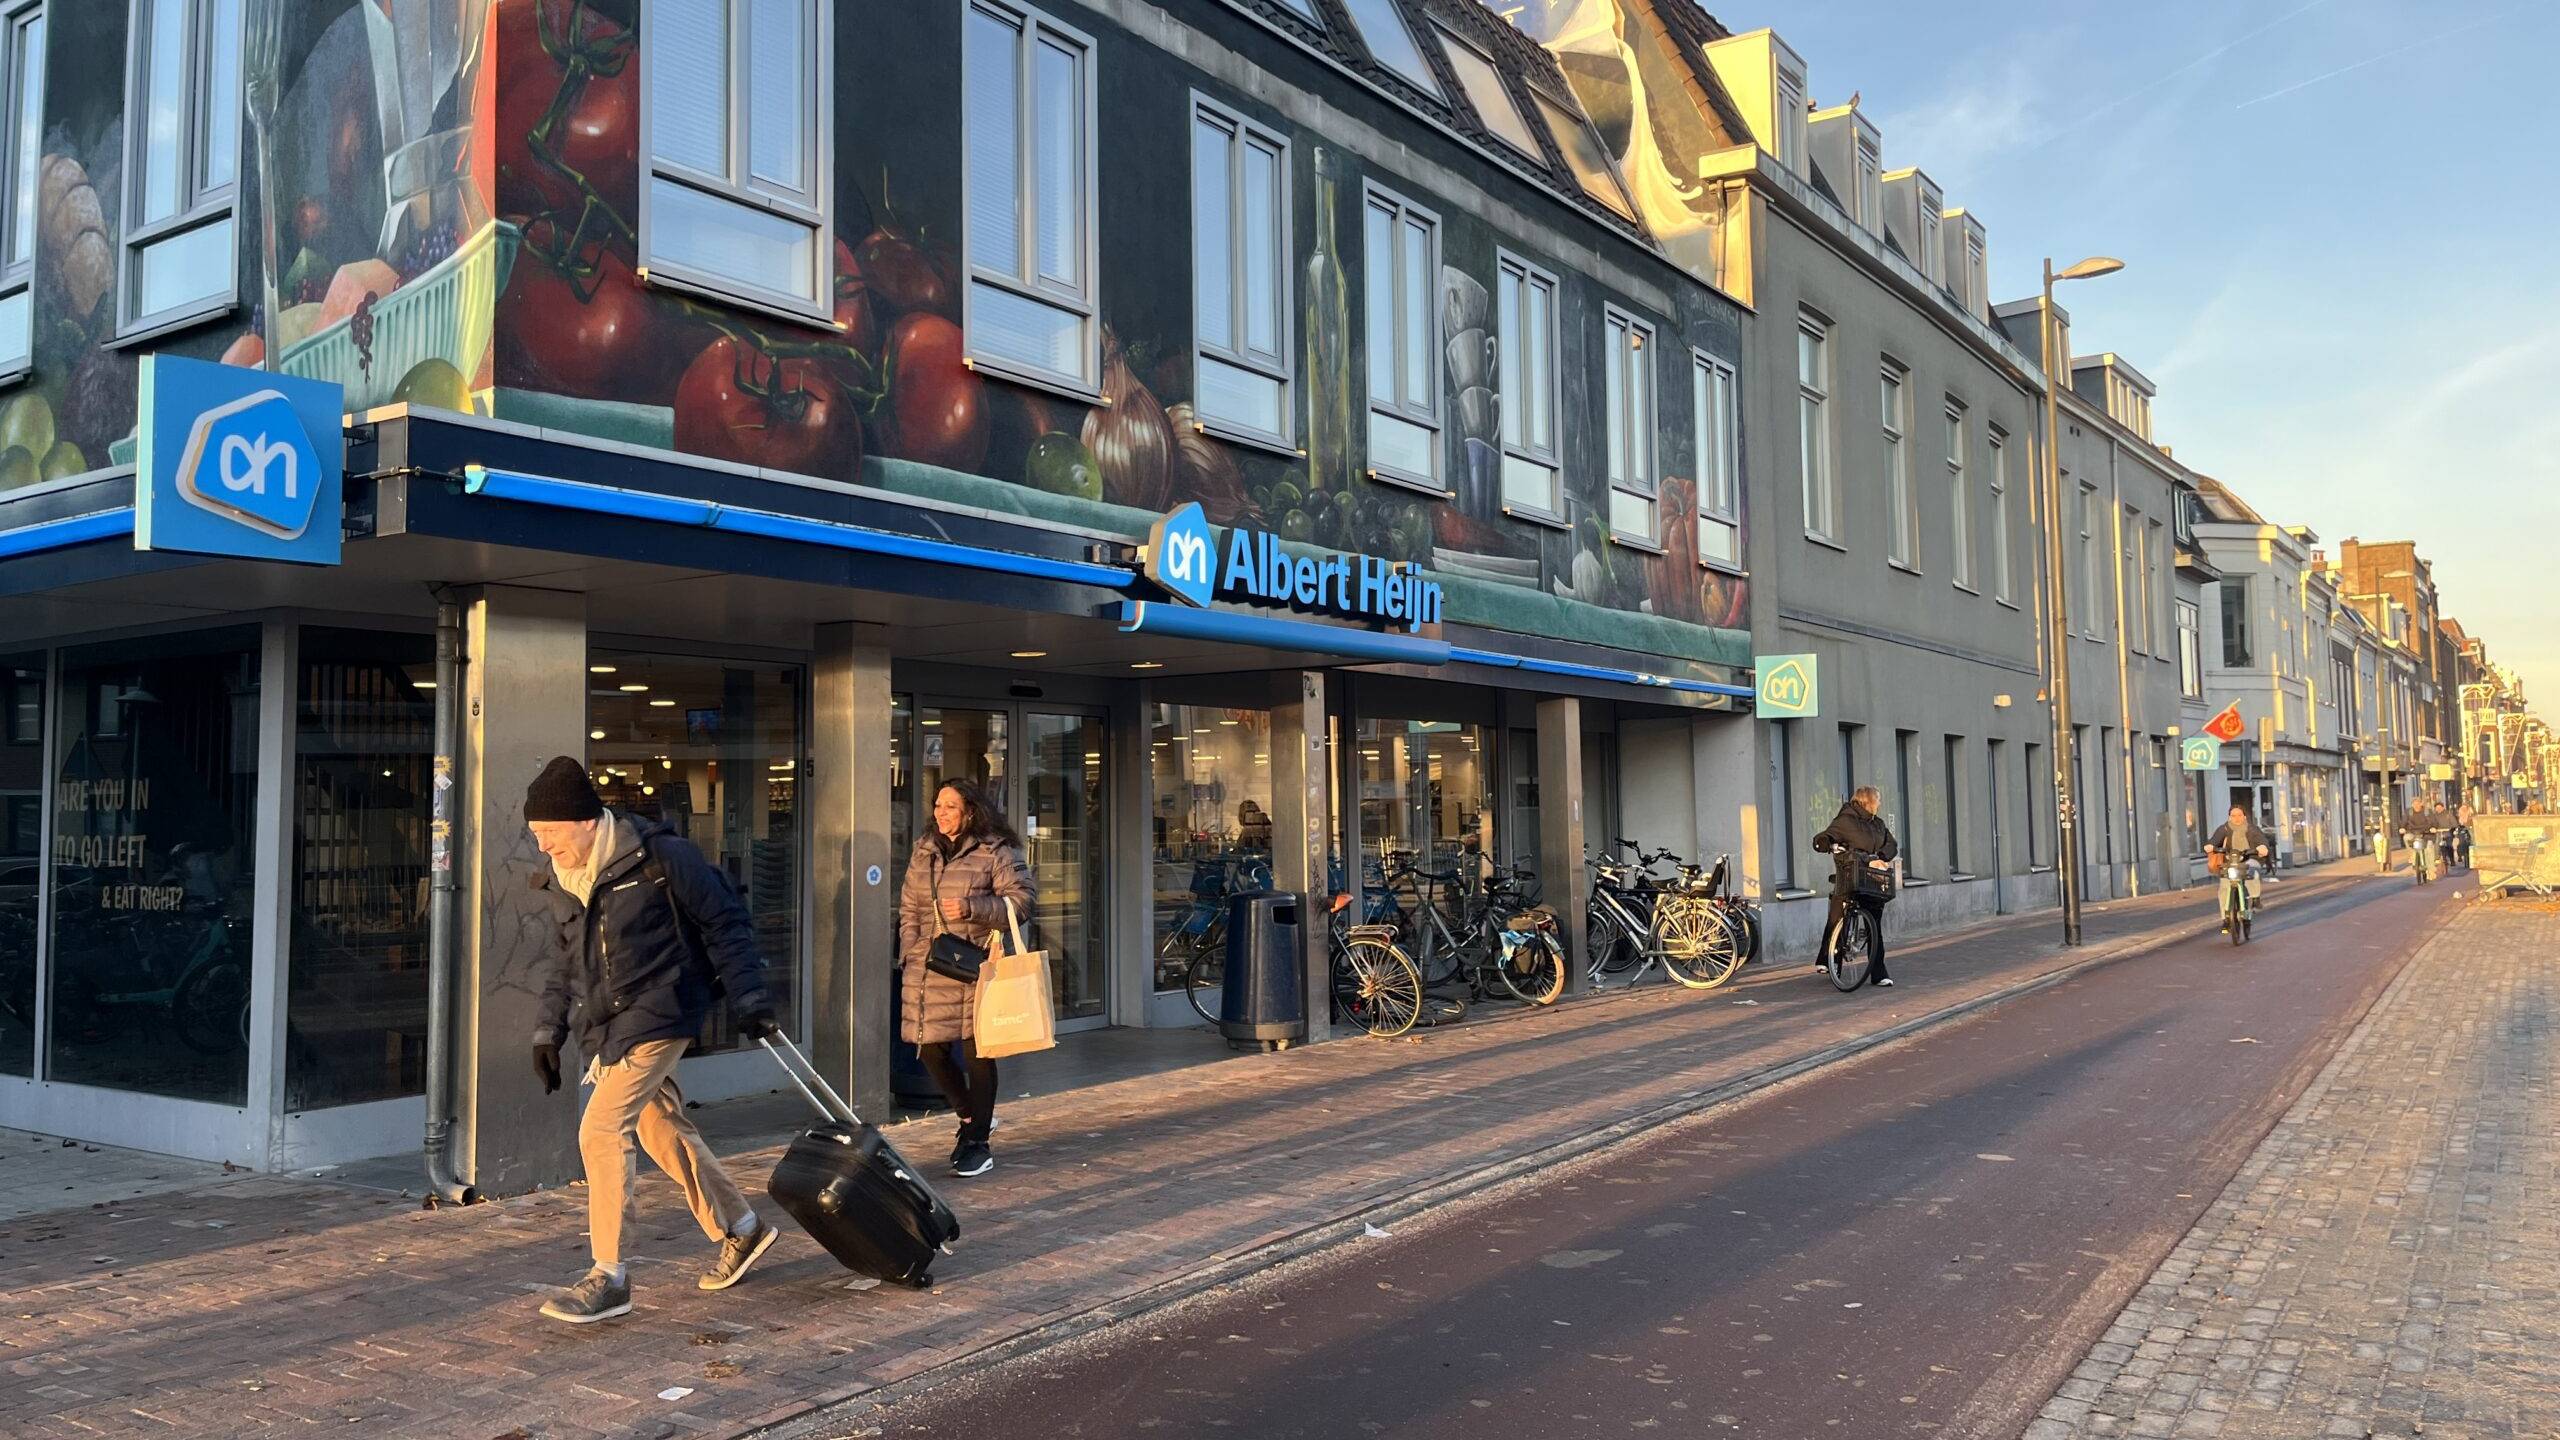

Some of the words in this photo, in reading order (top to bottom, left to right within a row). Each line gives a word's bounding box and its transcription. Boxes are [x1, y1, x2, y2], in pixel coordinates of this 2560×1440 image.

[1223, 528, 1350, 610] Albert
[1359, 554, 1441, 633] Heijn
[58, 780, 89, 811] ARE
[93, 779, 125, 811] YOU
[131, 778, 149, 811] IN
[56, 835, 76, 864] TO
[80, 835, 103, 867] GO
[108, 834, 147, 868] LEFT
[102, 886, 111, 909] &
[115, 886, 137, 910] EAT
[140, 886, 183, 911] RIGHT?
